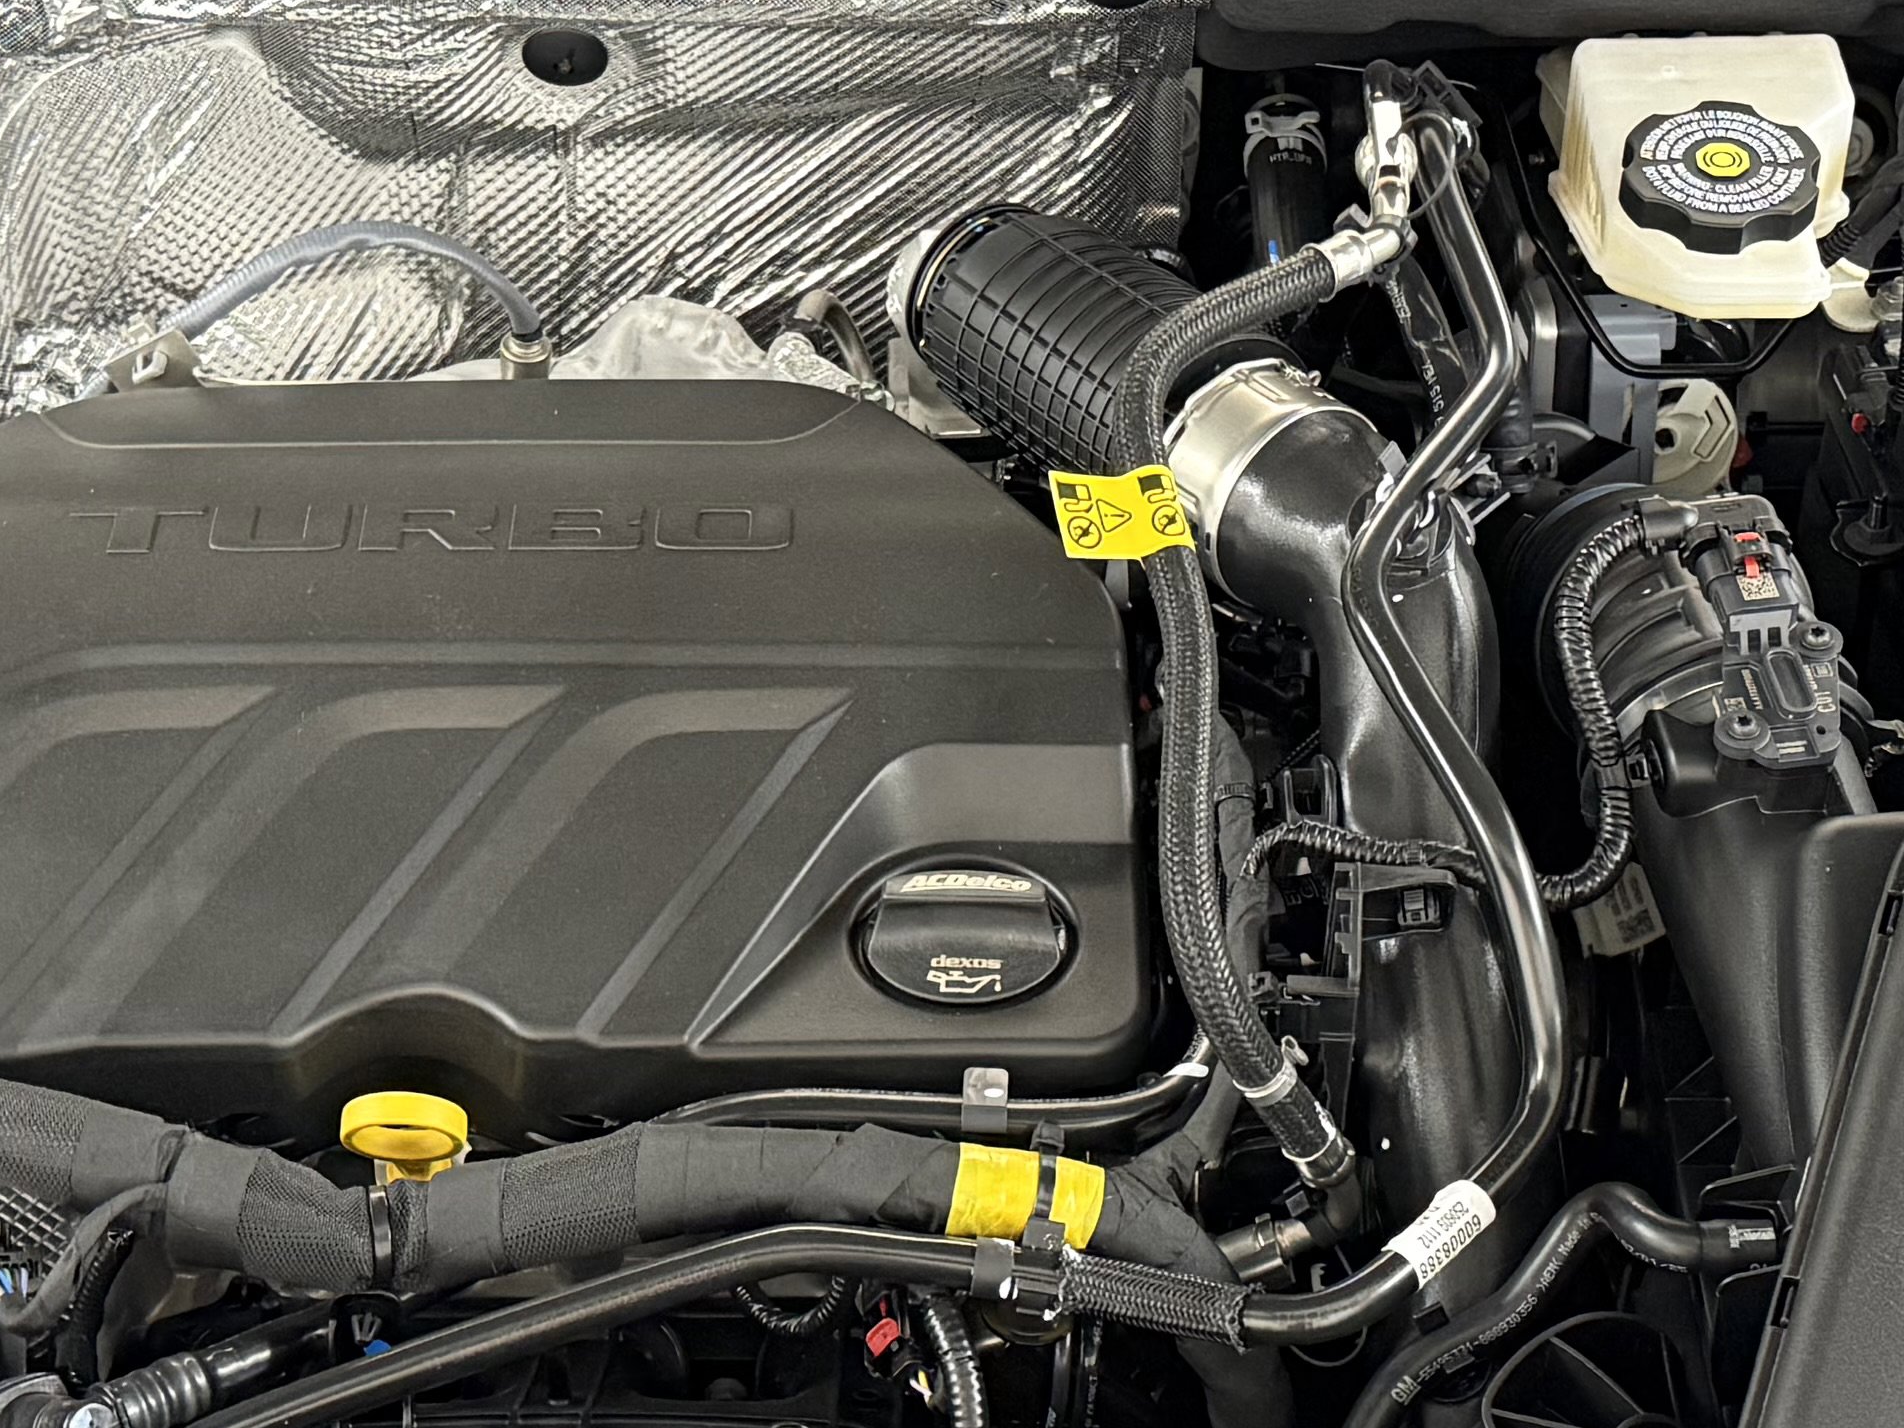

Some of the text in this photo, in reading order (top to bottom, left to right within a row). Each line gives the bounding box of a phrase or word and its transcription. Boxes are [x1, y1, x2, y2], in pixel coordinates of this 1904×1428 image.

[70, 503, 795, 555] TURBO
[901, 874, 1032, 893] ACDelco
[930, 954, 1004, 970] dexos
